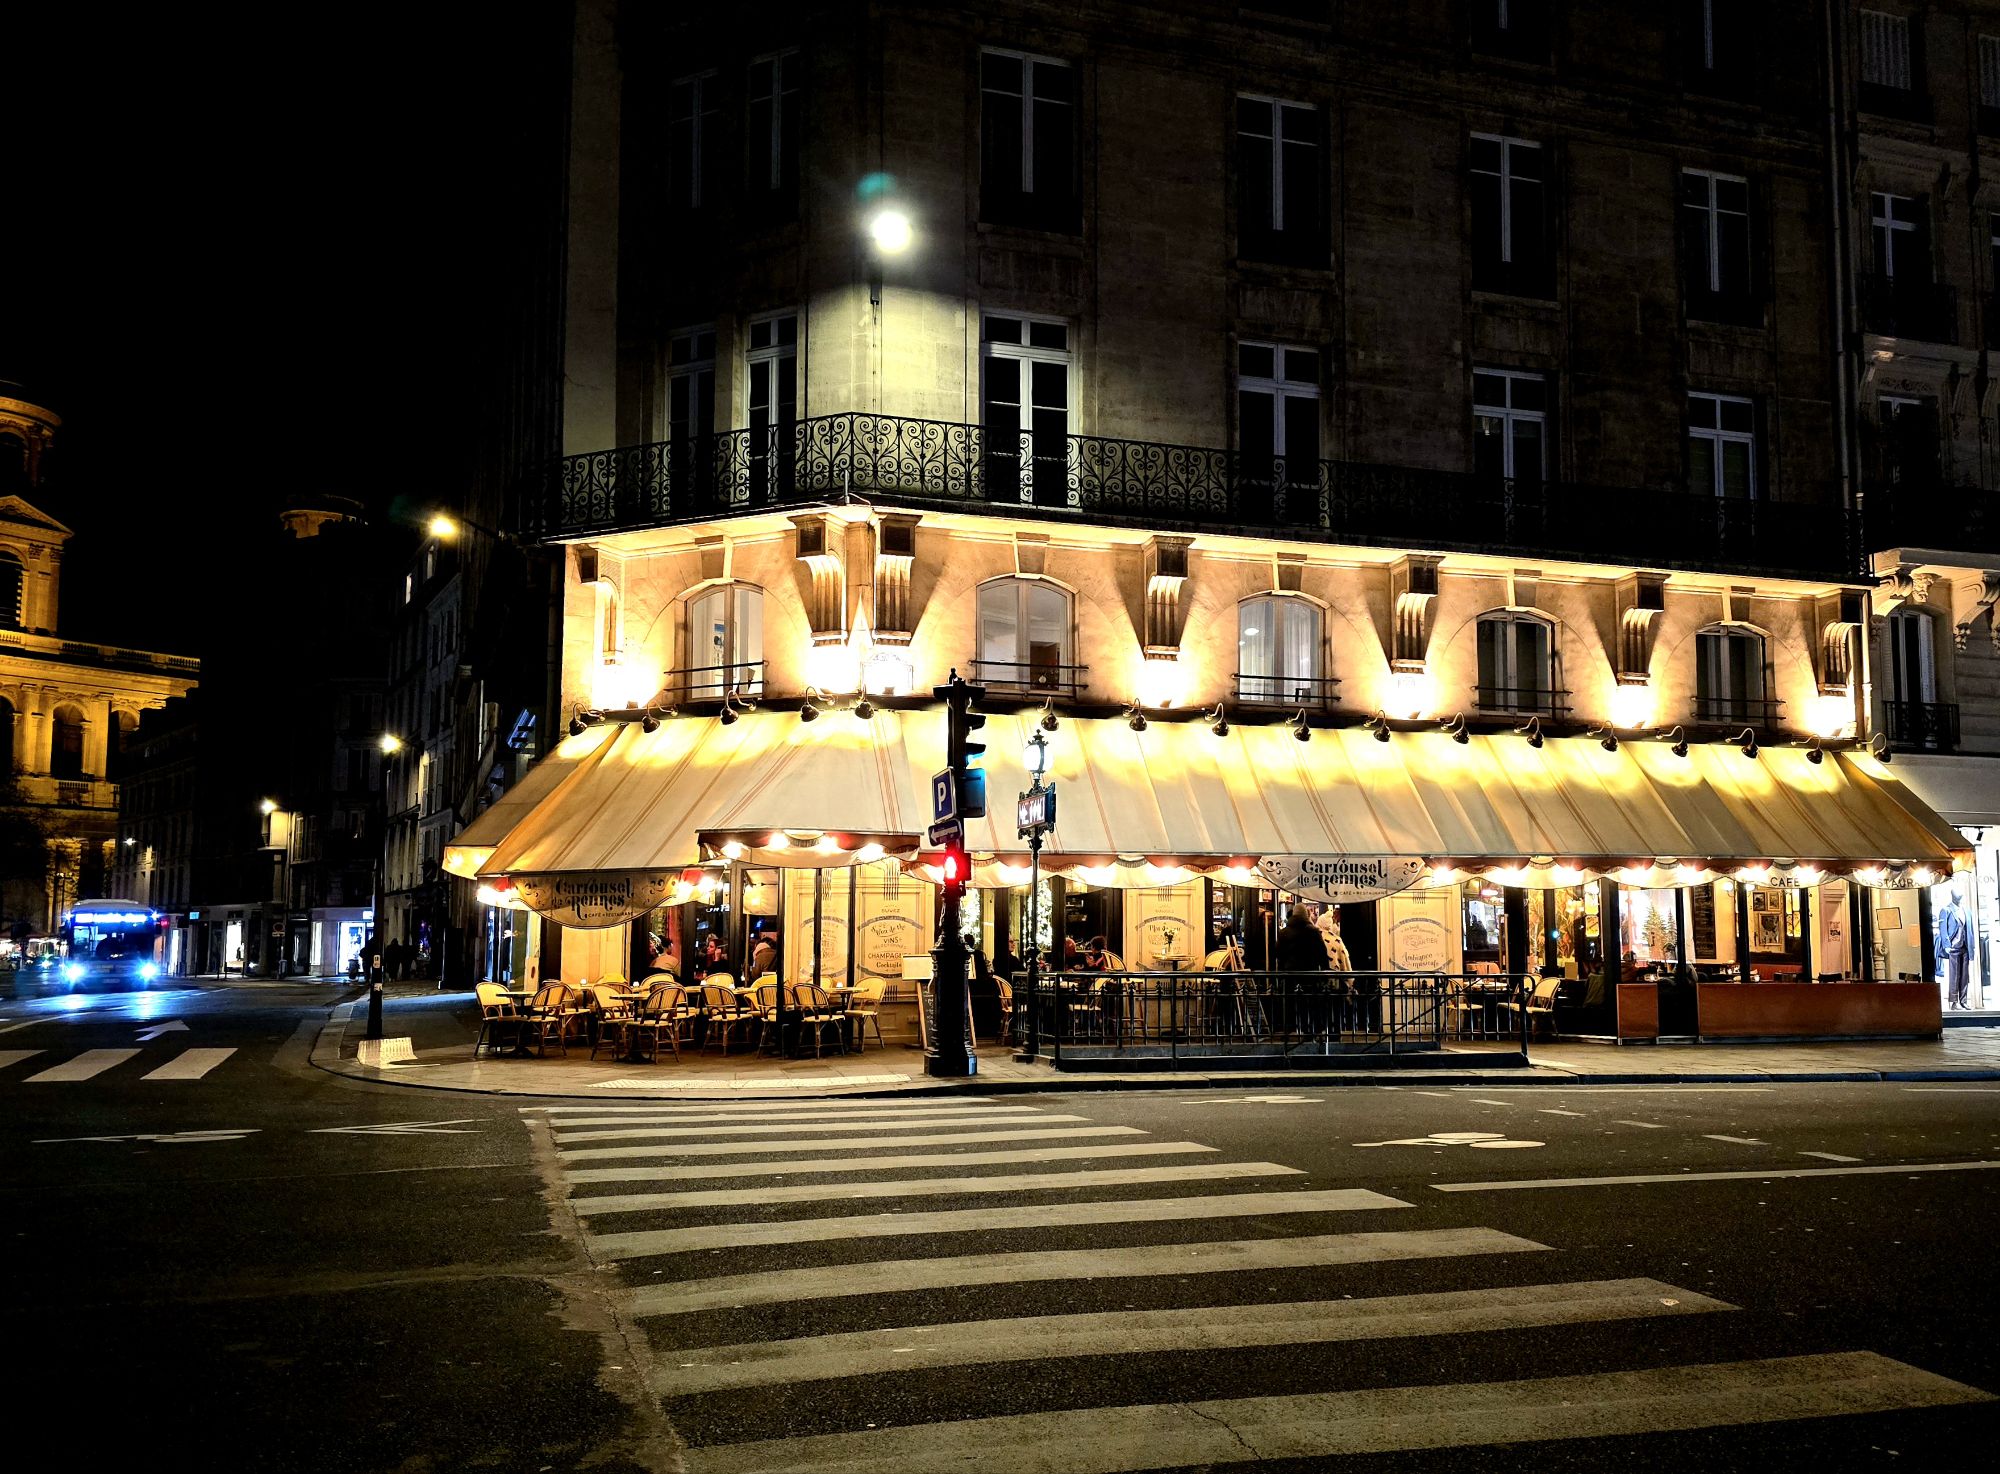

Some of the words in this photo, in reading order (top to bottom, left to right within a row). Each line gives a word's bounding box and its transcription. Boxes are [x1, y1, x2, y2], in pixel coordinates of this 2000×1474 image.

[937, 781, 947, 812] P
[1301, 857, 1388, 878] Carrousel
[555, 877, 635, 898] Carrousel
[1297, 874, 1310, 888] de
[1312, 873, 1377, 897] Rennes
[551, 896, 563, 909] de
[566, 893, 626, 921] Rennes
[883, 936, 899, 944] VINS
